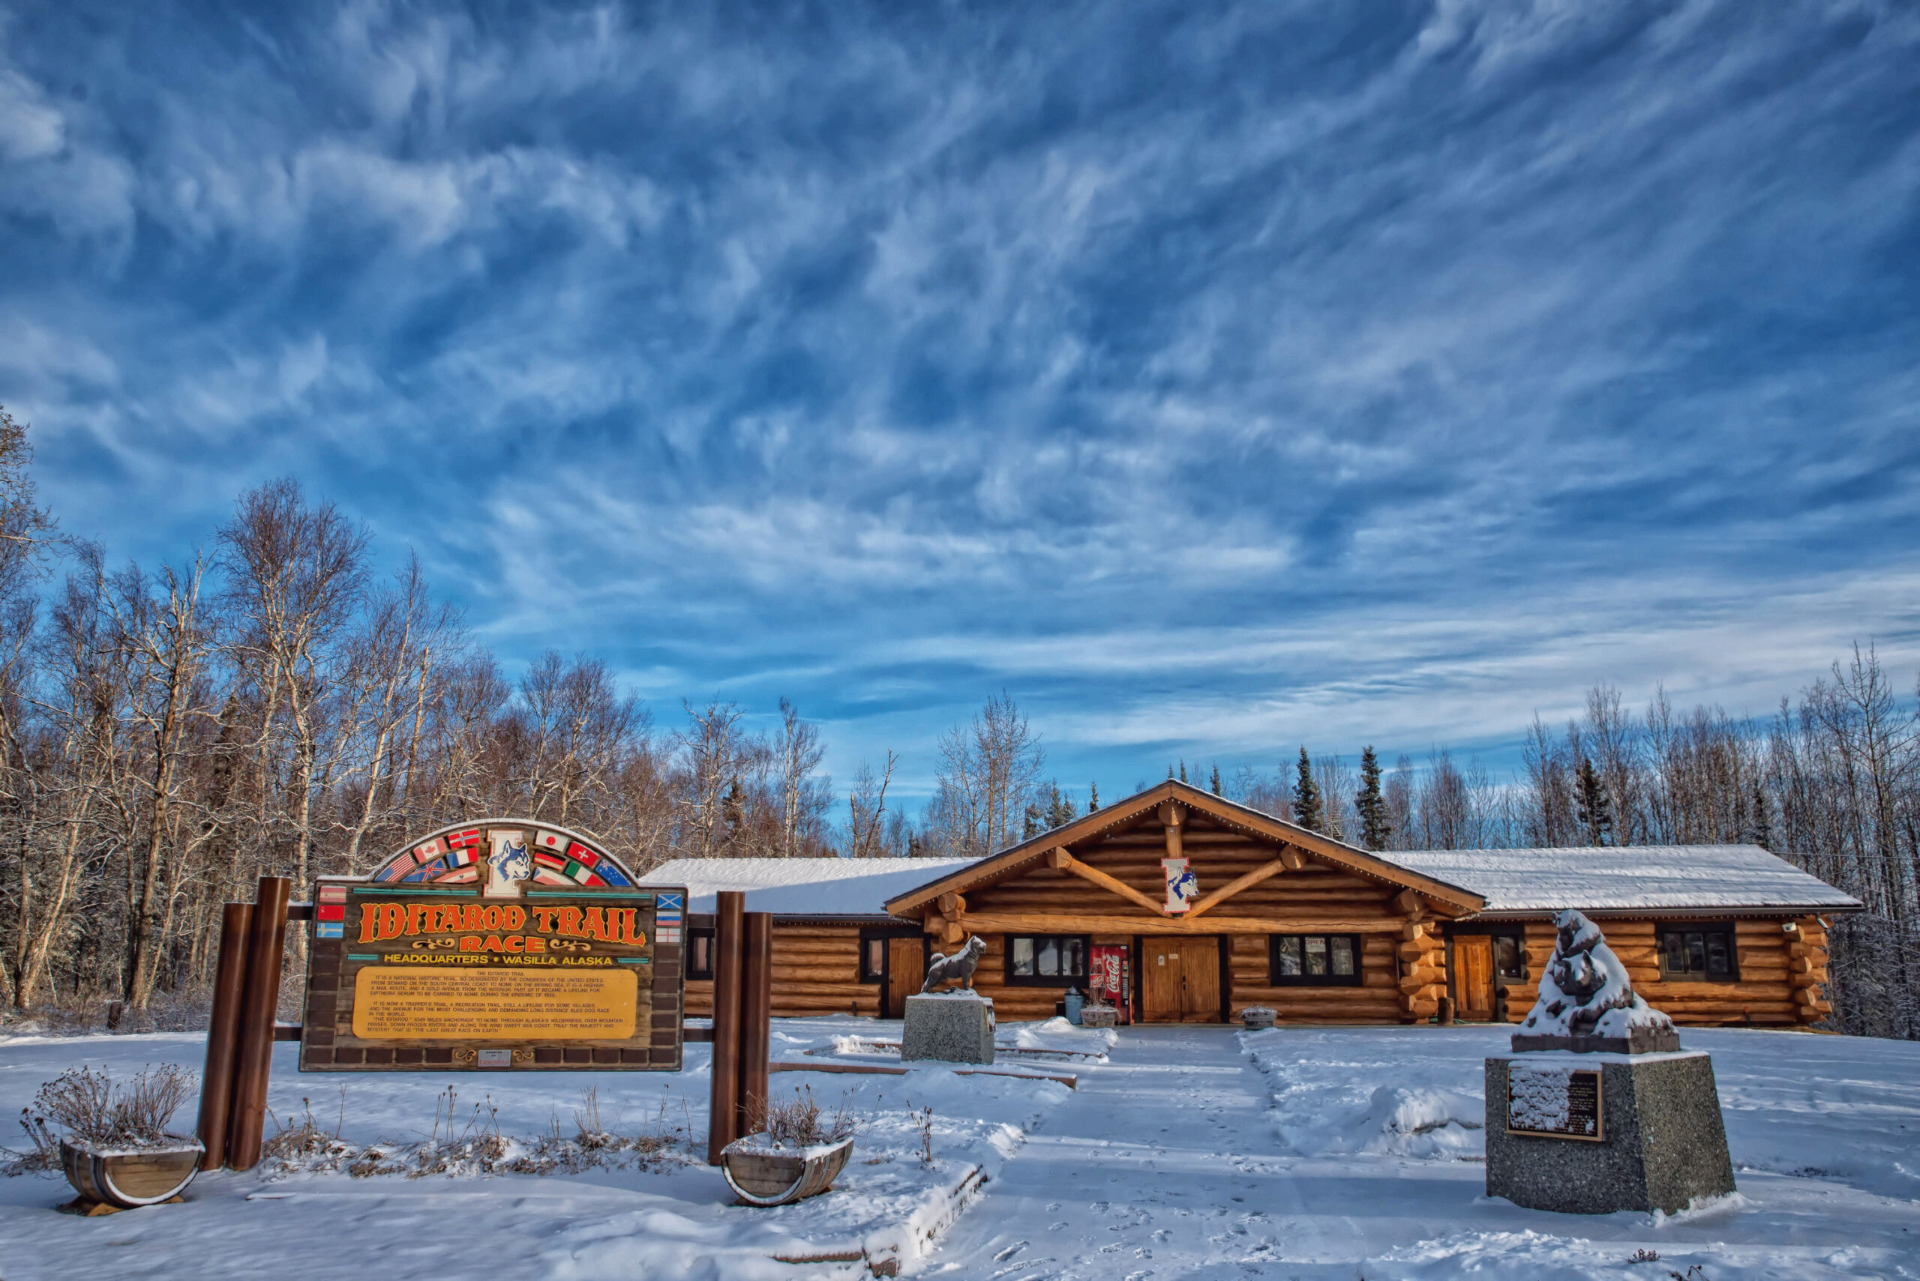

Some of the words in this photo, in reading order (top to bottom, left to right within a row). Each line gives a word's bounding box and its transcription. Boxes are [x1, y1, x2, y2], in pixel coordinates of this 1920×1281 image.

[357, 902, 527, 944] IDITAROD
[532, 906, 647, 948] TRAIL
[459, 935, 546, 953] RACE
[383, 953, 489, 964] HEADQUARTERS
[503, 955, 557, 965] WASILLA
[562, 956, 613, 966] ALASKA
